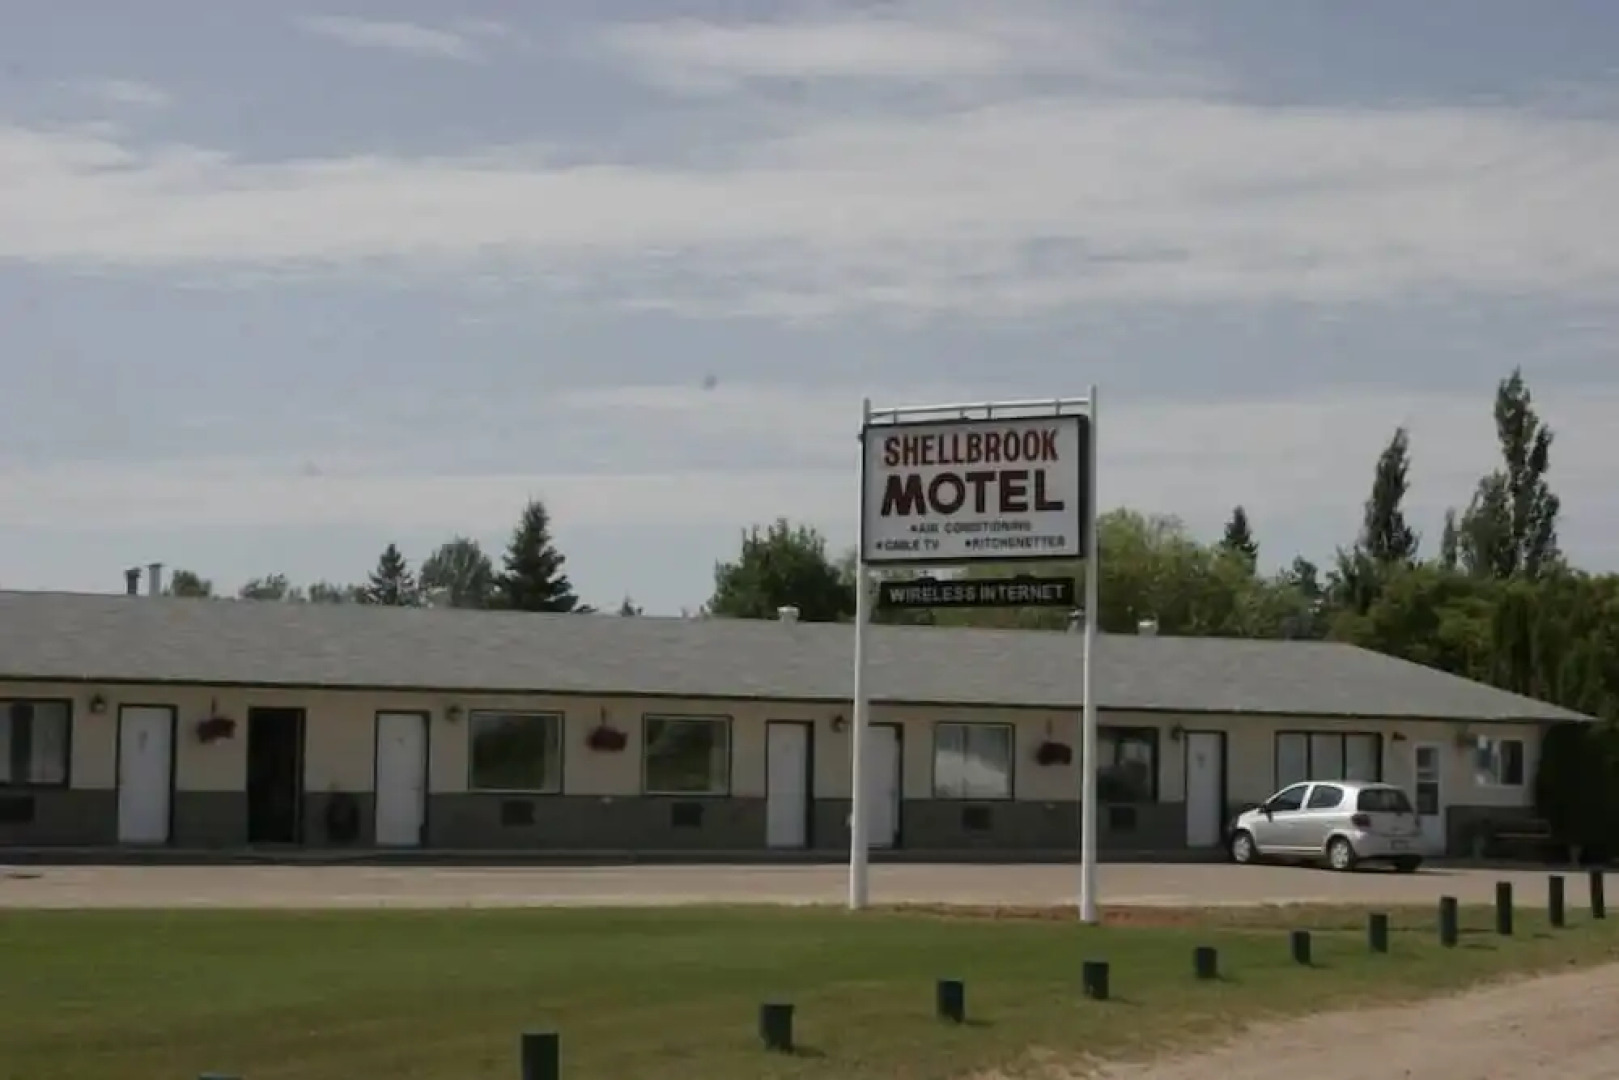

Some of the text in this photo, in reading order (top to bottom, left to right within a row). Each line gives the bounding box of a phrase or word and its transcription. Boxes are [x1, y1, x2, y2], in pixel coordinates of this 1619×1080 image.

[884, 429, 1059, 467] SHELLBROOK
[881, 469, 1065, 517] MOTEL
[924, 538, 940, 551] TV
[889, 583, 1066, 603] WIRELESS INTERNET
